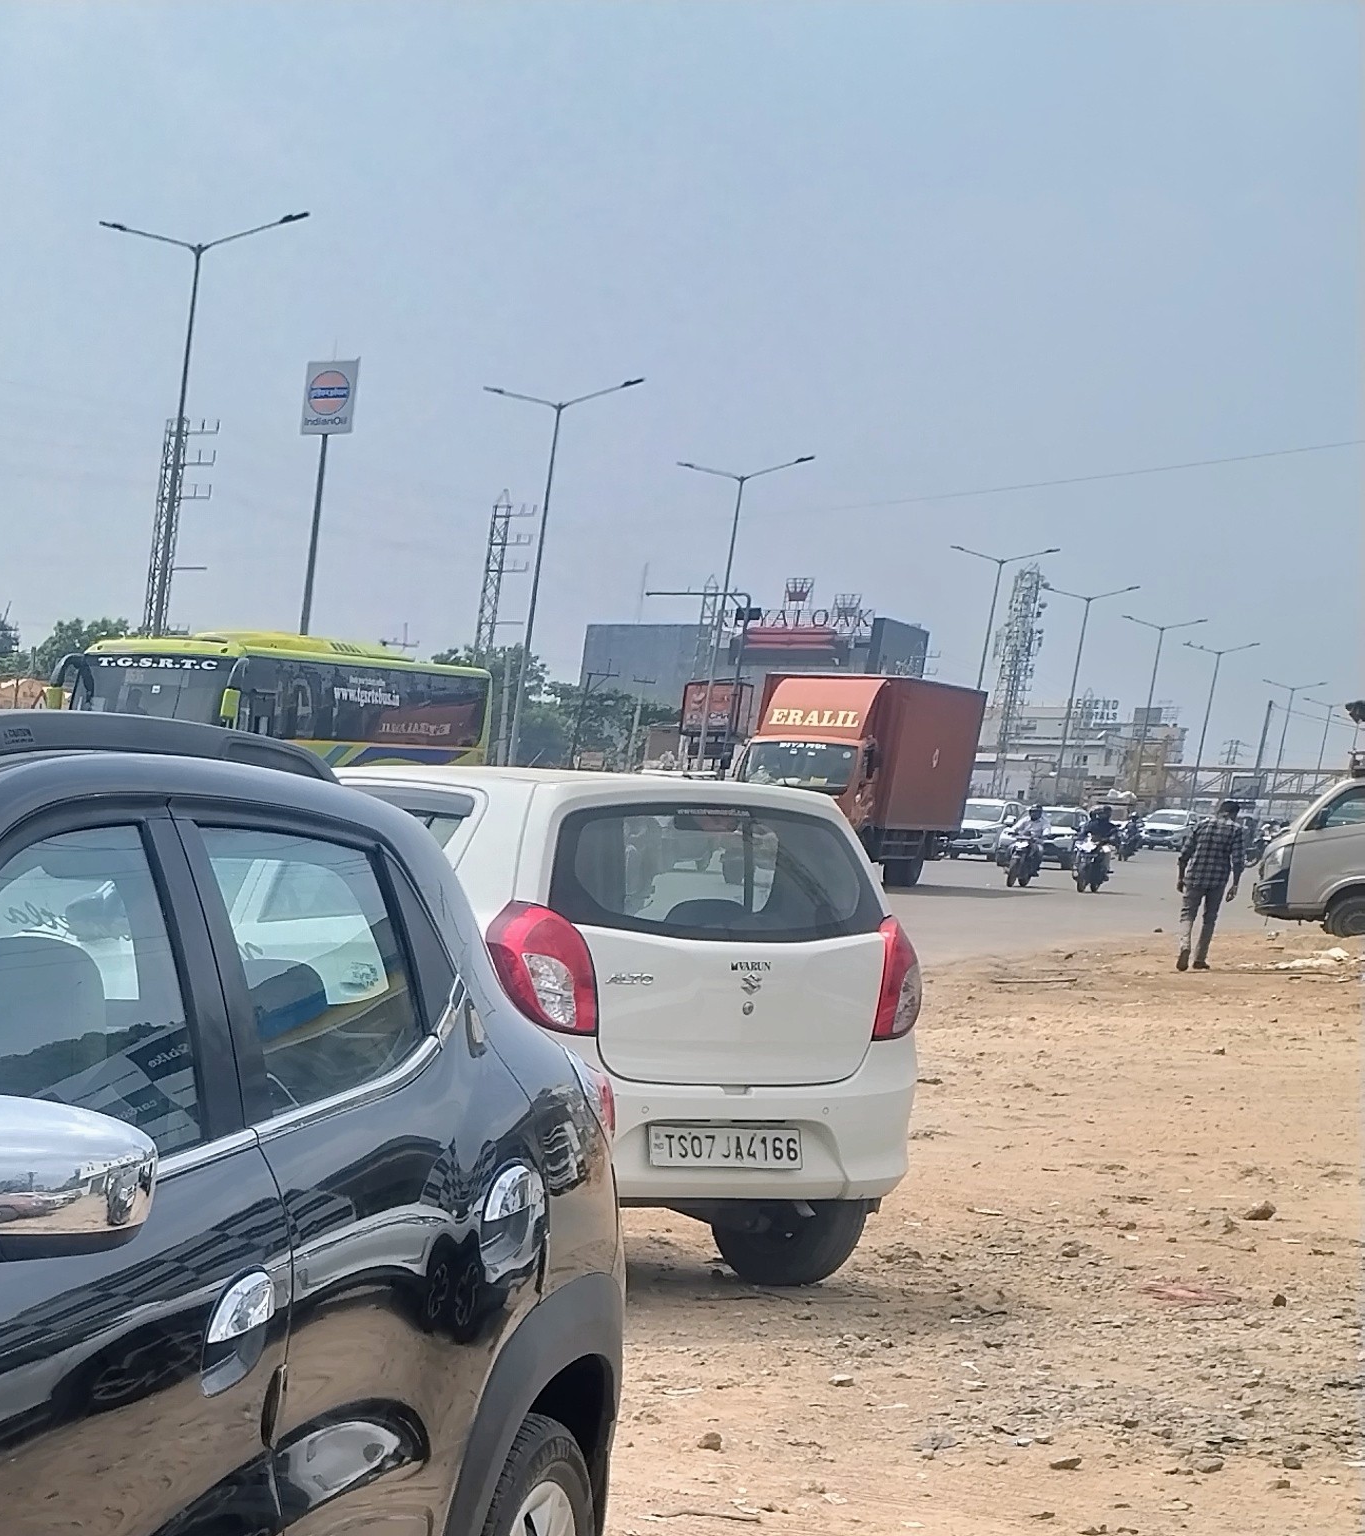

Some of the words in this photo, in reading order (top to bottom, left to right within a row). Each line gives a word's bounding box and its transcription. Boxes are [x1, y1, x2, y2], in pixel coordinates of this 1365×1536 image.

[769, 708, 860, 728] ERALIL
[739, 961, 771, 971] VARUN
[605, 973, 654, 985] ALTO
